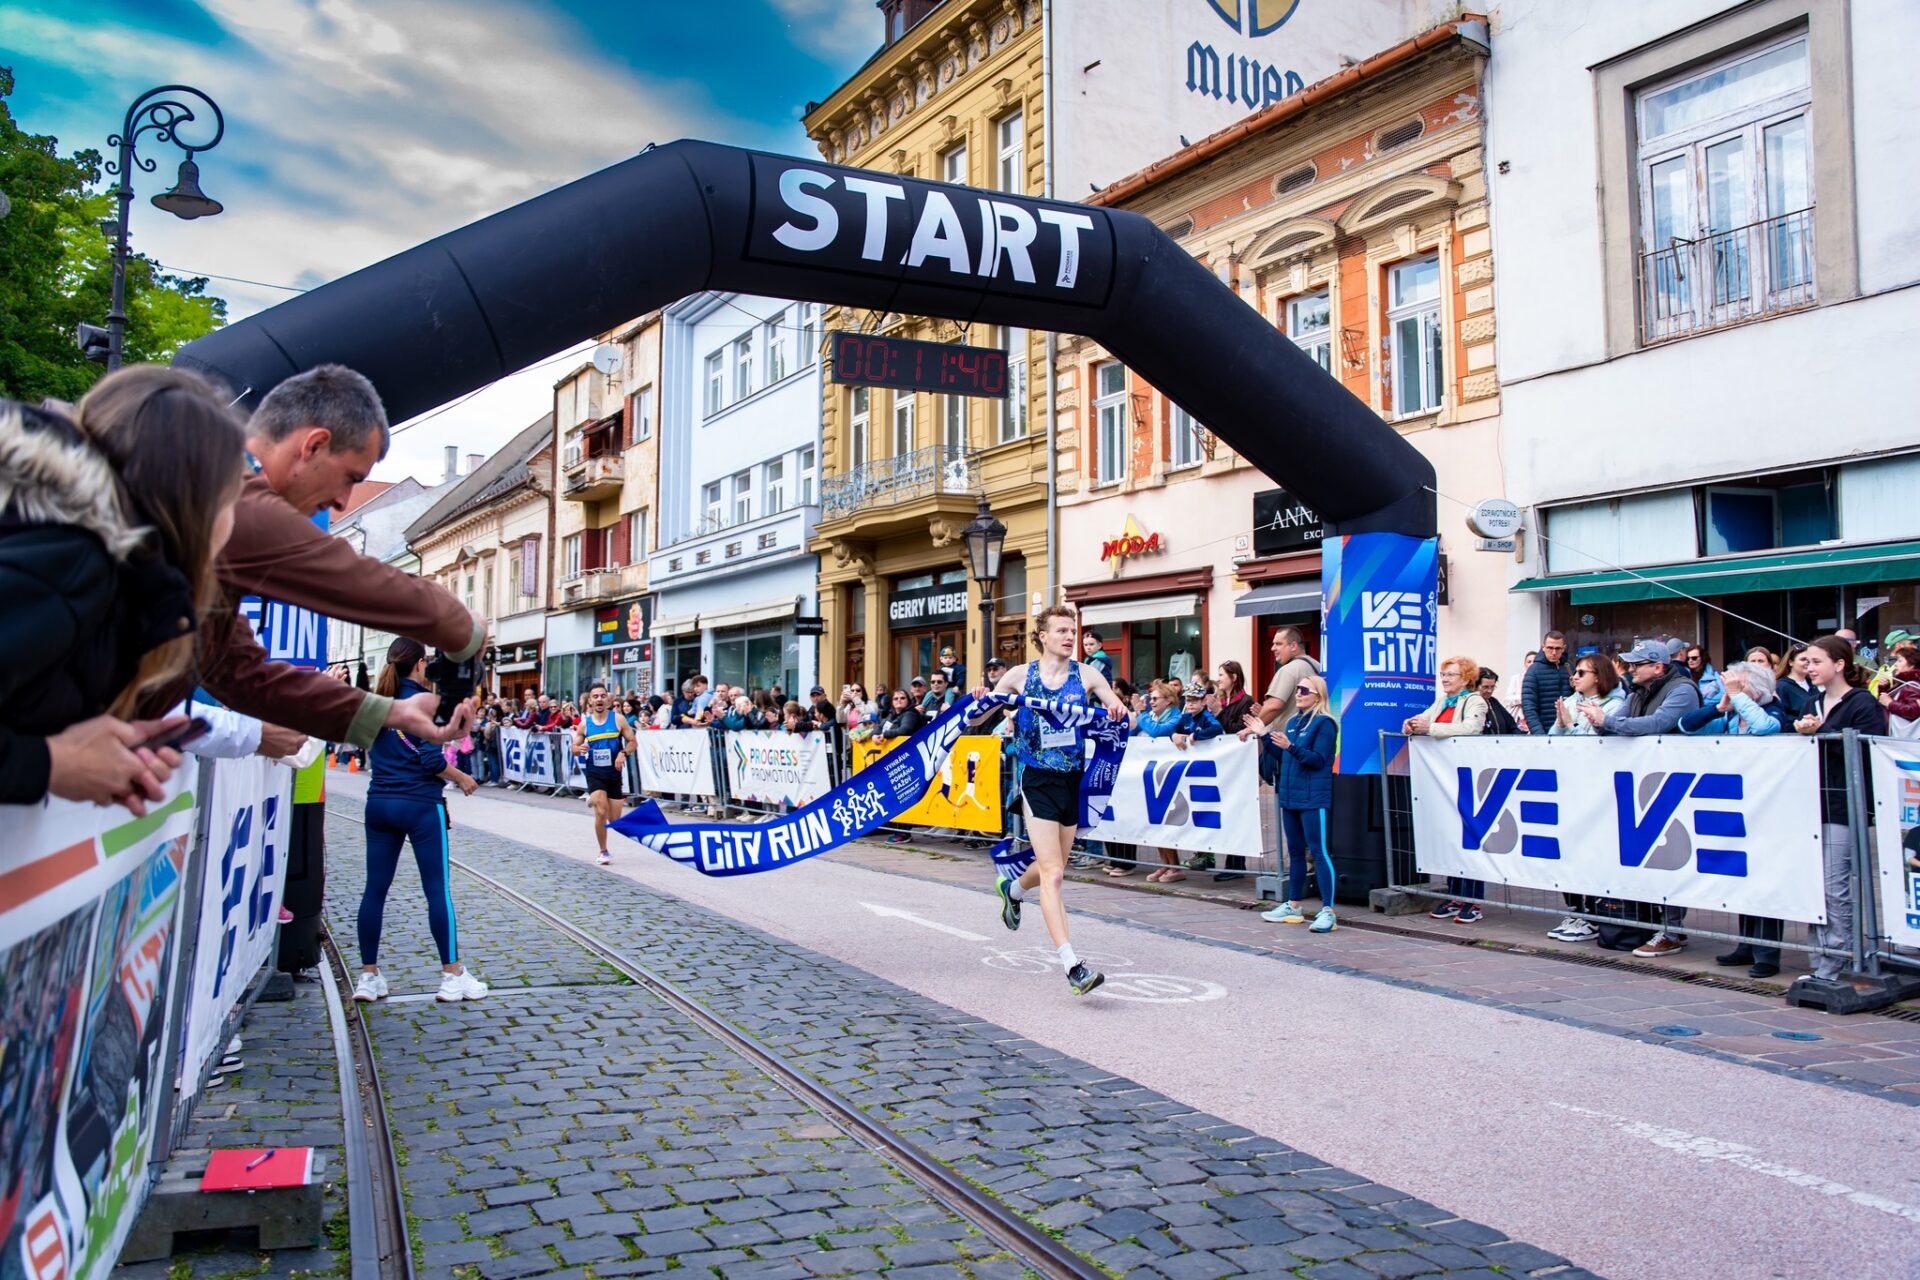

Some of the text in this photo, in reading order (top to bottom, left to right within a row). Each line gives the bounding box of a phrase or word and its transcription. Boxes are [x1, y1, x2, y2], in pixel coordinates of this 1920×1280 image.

[772, 168, 1094, 289] START
[838, 337, 1005, 393] 00:11:40
[1101, 532, 1159, 562] MÓDA
[890, 592, 968, 620] GERRY WEBER
[1364, 681, 1402, 689] VYHRÁVA
[659, 746, 695, 774] KOŠICE
[750, 748, 798, 767] PROGRESS
[884, 752, 910, 772] VYHRÁVA
[751, 767, 801, 784] PROMOTION
[888, 763, 908, 779] JEDEN,
[890, 766, 915, 785] POMÁHA
[893, 774, 912, 791] KAŽDÝ
[699, 808, 833, 872] CiTY RUN
